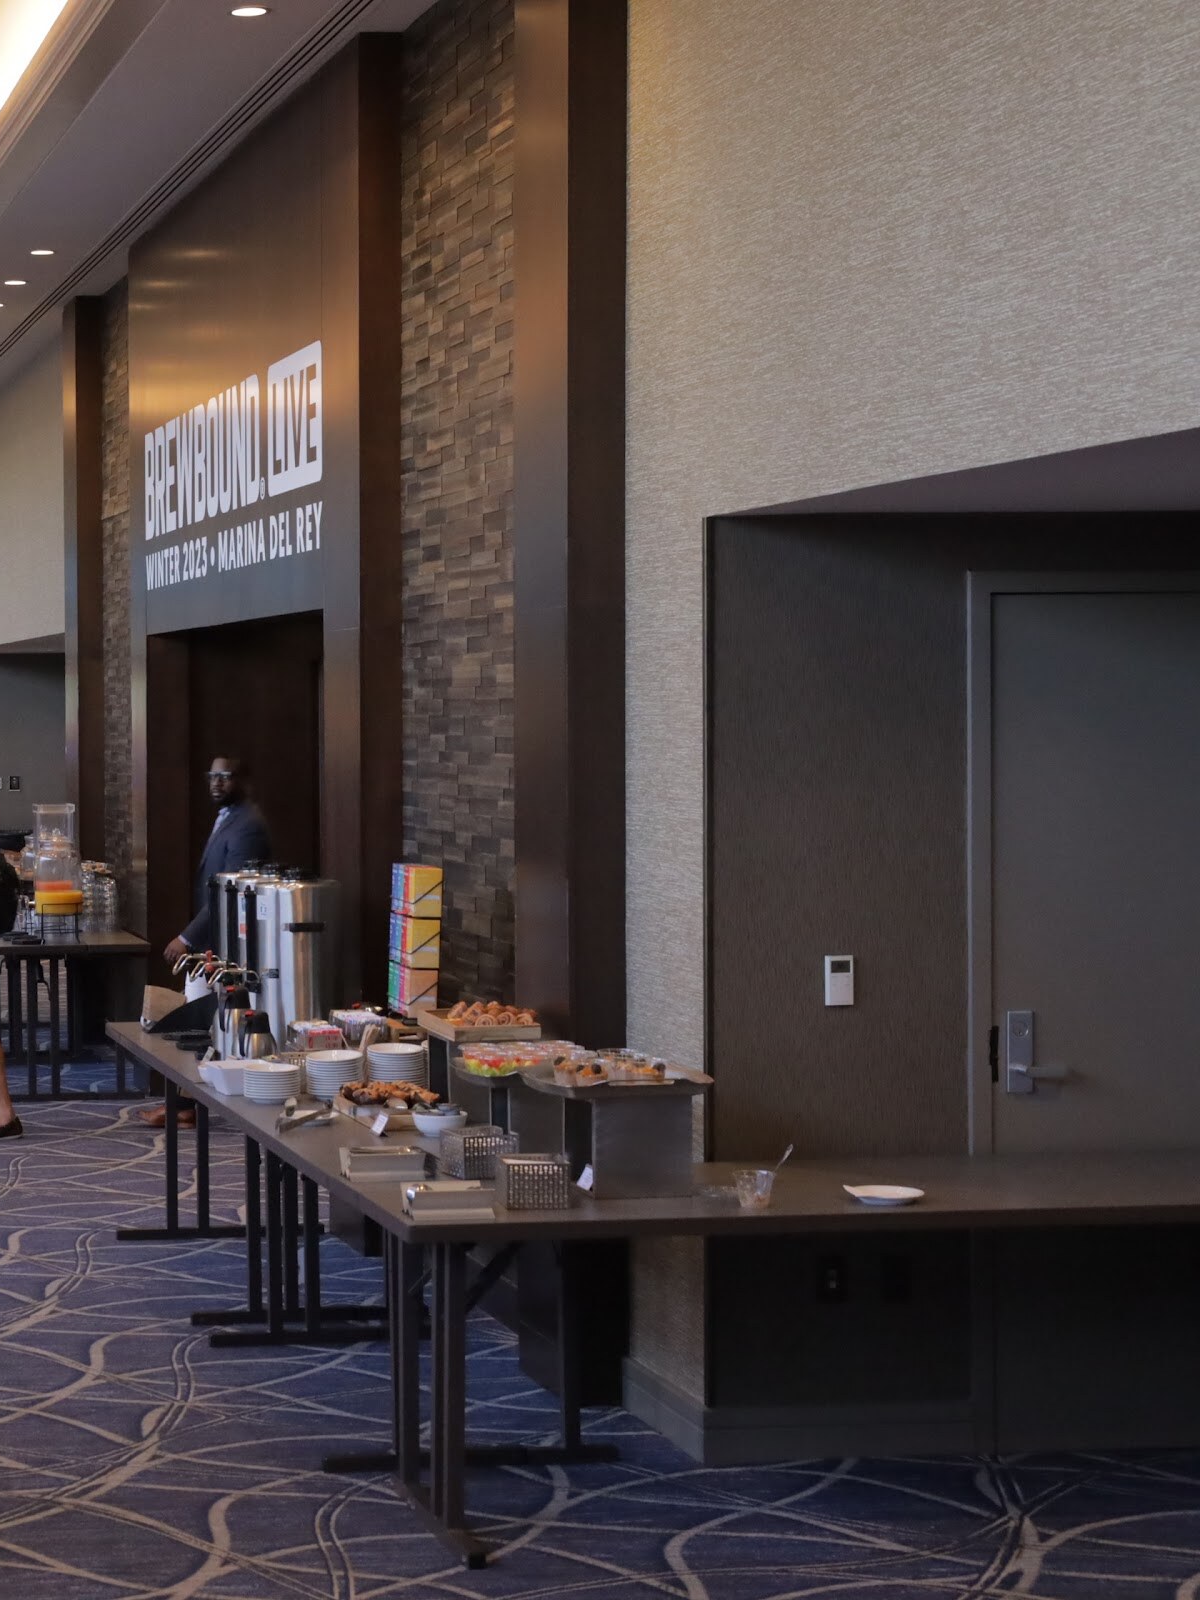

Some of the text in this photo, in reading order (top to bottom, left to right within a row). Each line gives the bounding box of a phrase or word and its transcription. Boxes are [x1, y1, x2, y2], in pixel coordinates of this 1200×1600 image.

[272, 363, 317, 476] LIVE
[145, 501, 323, 591] WINTER 2023 MARINA DEL REY
